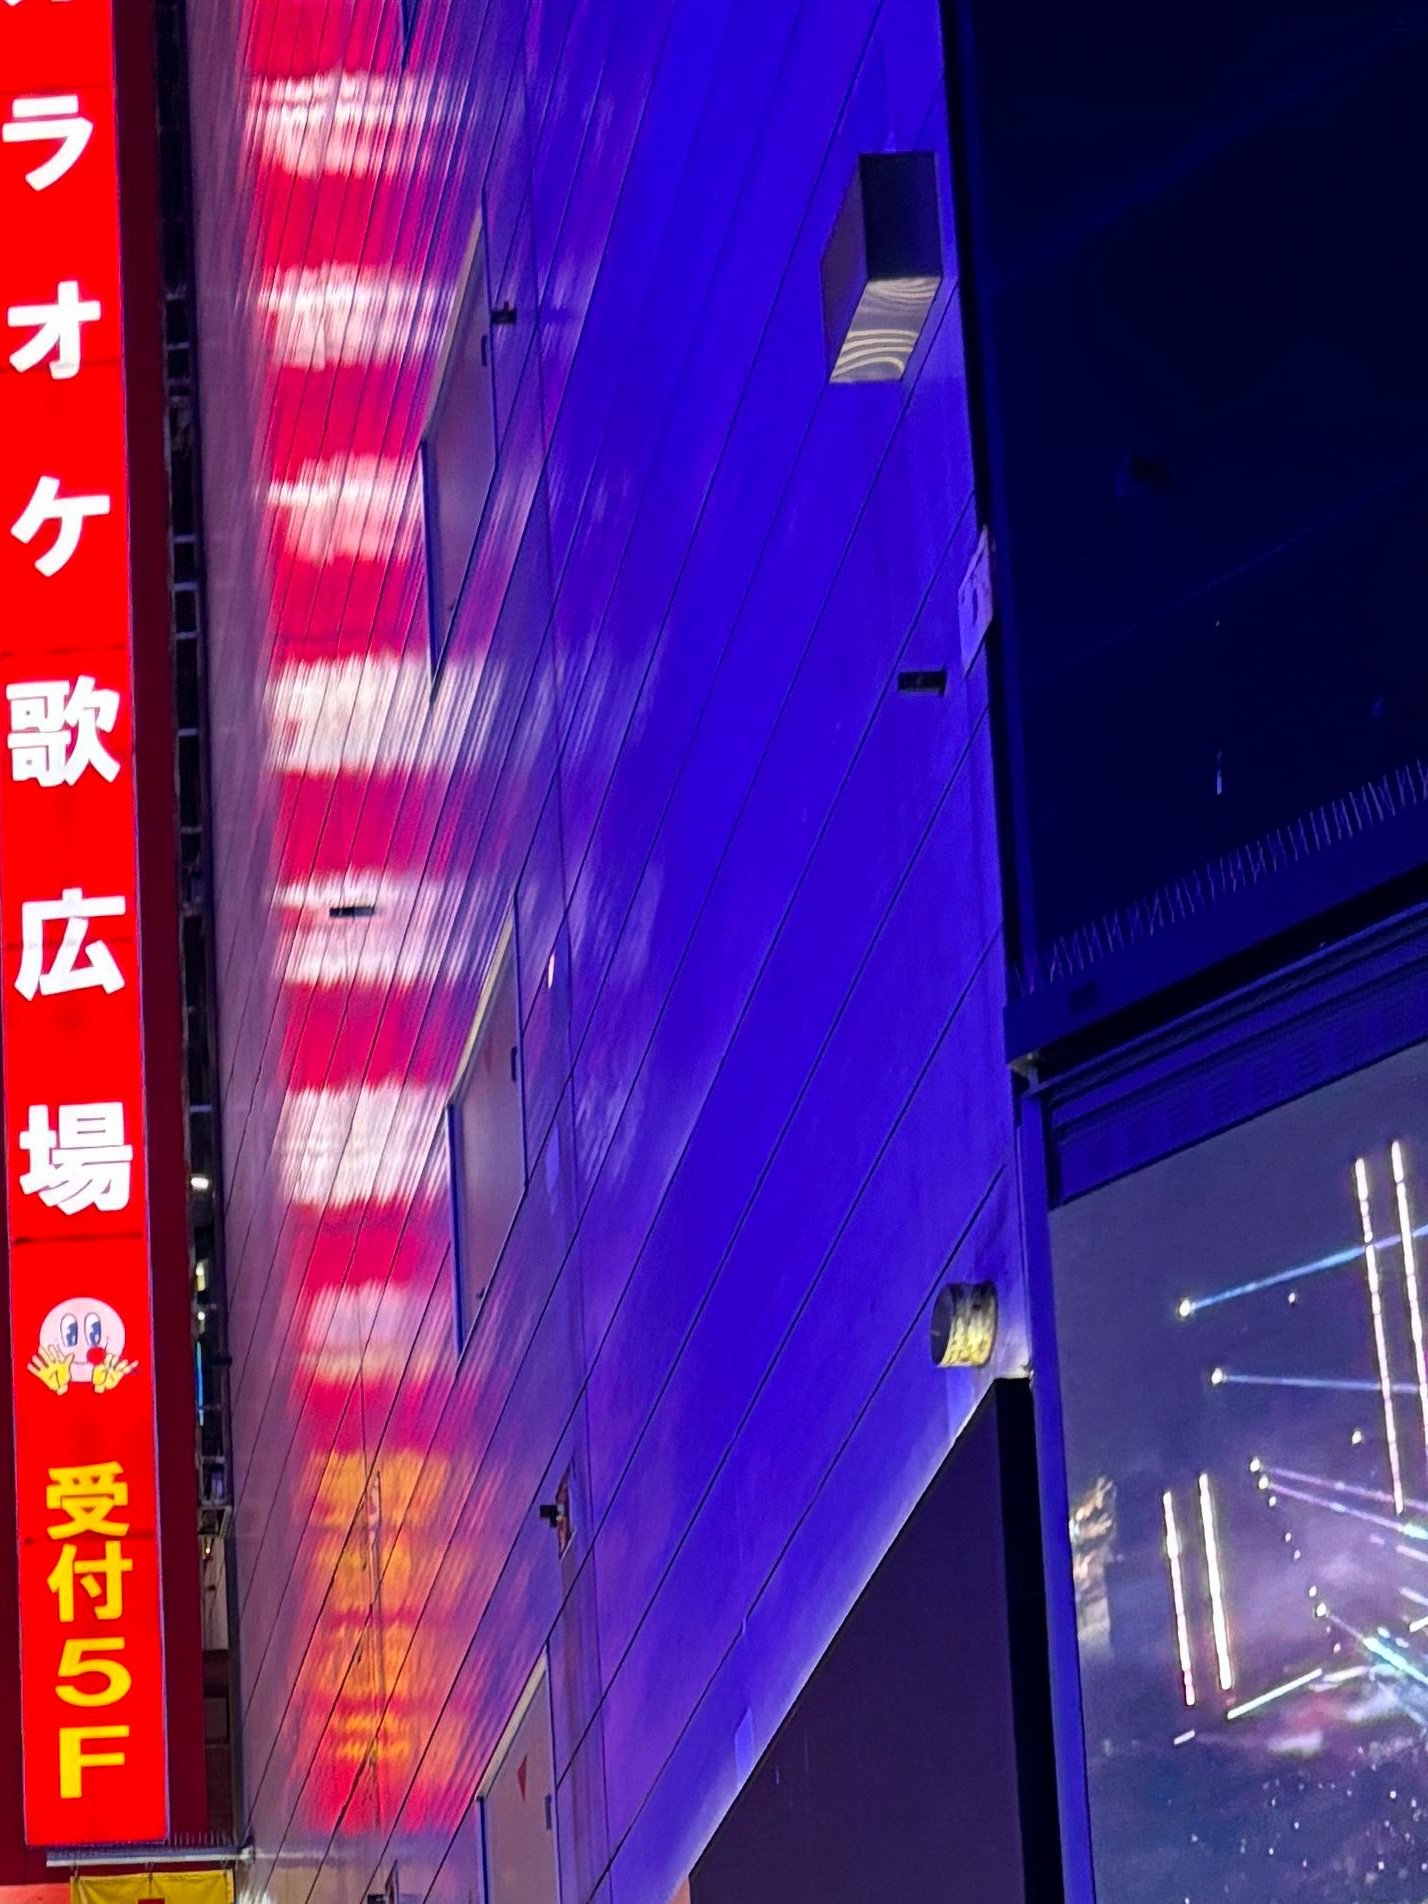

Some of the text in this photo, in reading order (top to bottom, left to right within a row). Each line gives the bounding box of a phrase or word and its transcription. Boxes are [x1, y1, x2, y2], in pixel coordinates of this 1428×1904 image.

[0, 0, 133, 1215] ラオケ歌広場
[44, 1461, 134, 1799] 受付5F
